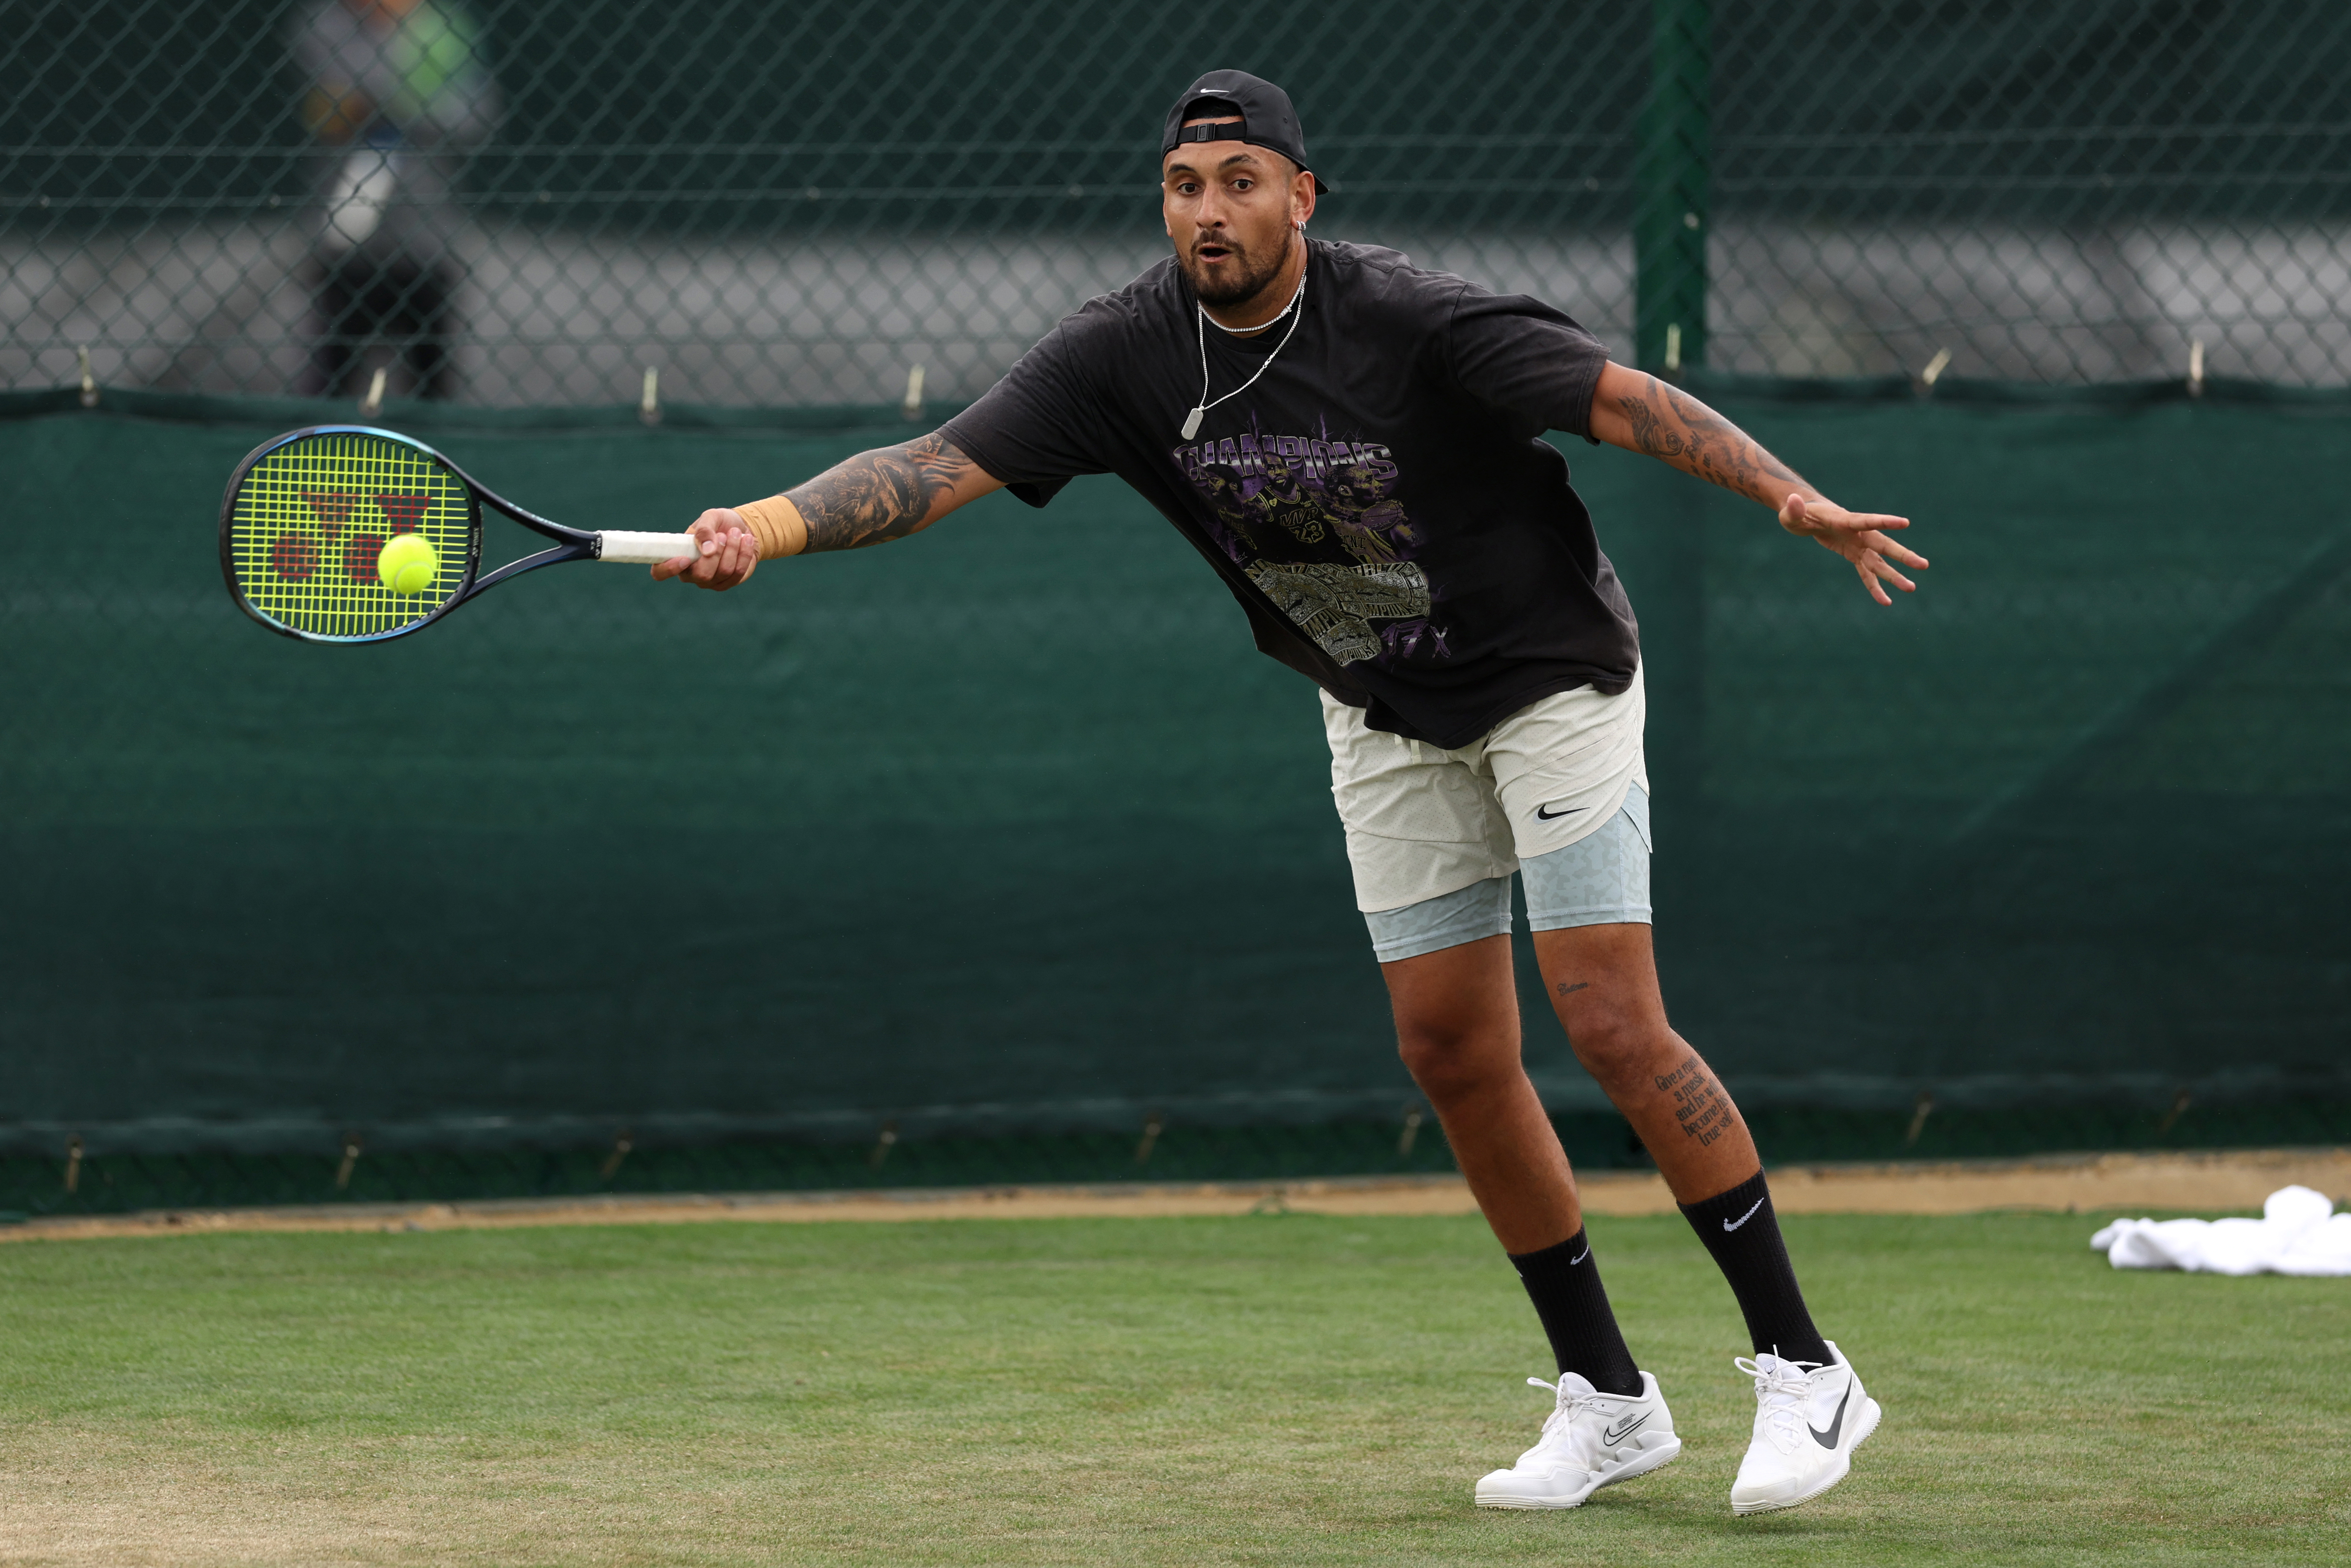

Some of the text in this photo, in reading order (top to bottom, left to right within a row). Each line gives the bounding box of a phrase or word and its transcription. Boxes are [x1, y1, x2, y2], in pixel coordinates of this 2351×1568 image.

[1173, 433, 1398, 482] CHAMPIONS
[1279, 507, 1319, 527] MVP
[1288, 520, 1325, 544] 23
[1366, 603, 1419, 616] MPIONS
[1654, 1055, 1699, 1092] Give a man
[1674, 1071, 1706, 1102] a mask
[1676, 1078, 1720, 1122] and he will
[1681, 1094, 1729, 1138] become his
[1697, 1108, 1734, 1147] true self
